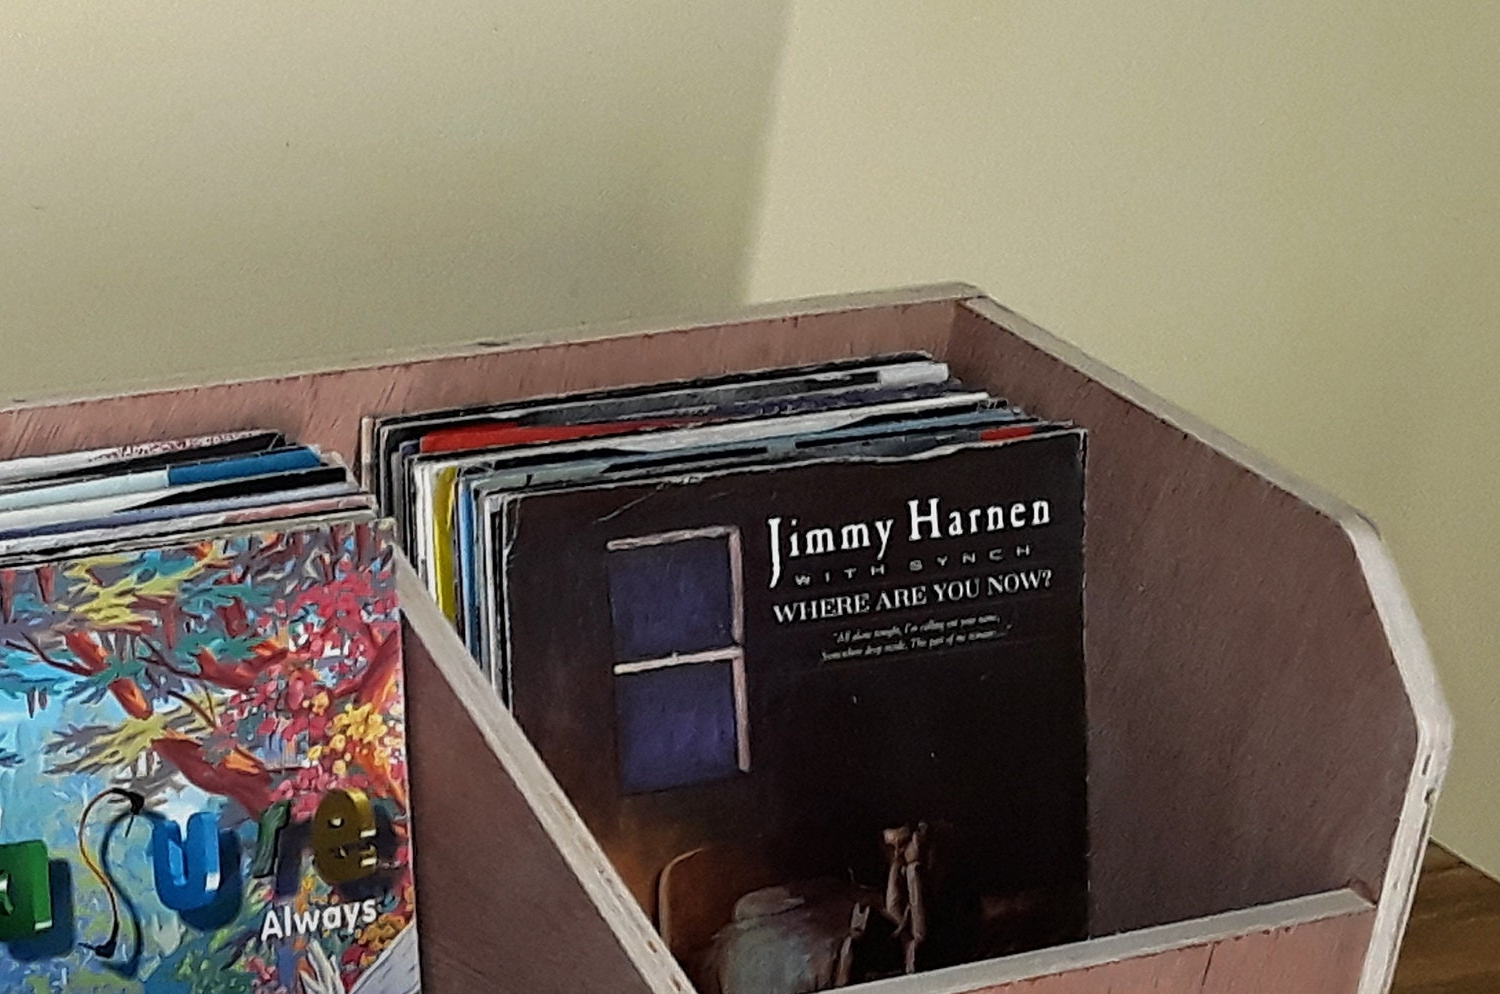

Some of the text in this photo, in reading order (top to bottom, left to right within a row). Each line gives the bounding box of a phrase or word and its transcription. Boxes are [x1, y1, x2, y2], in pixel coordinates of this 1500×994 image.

[767, 497, 1051, 589] Jimmy Harnen
[794, 544, 1032, 586] WITH SYNCH
[773, 568, 1052, 623] WHERE ARE YOU NOW?
[260, 899, 378, 942] Always
